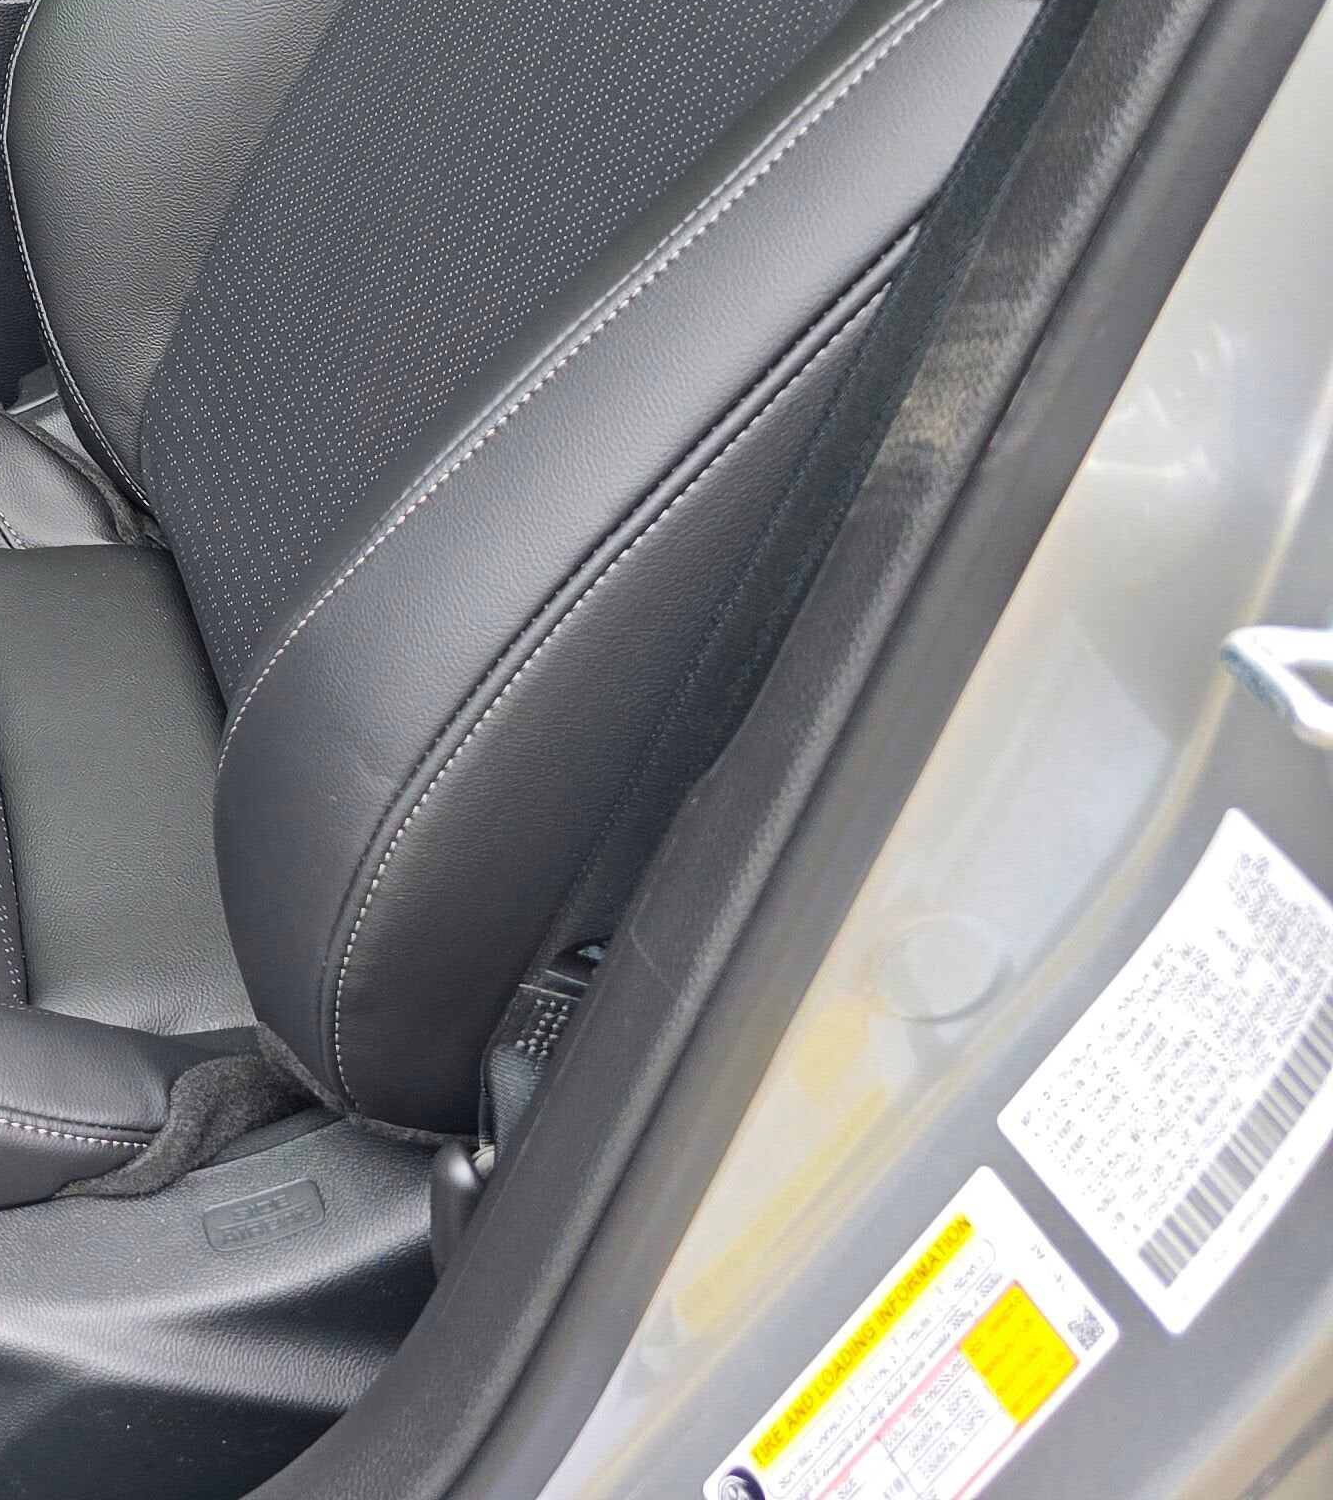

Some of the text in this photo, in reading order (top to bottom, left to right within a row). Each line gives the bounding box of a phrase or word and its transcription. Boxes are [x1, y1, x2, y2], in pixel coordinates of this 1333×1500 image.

[751, 1215, 972, 1465] TIRE AND LOADING INFORMATION
